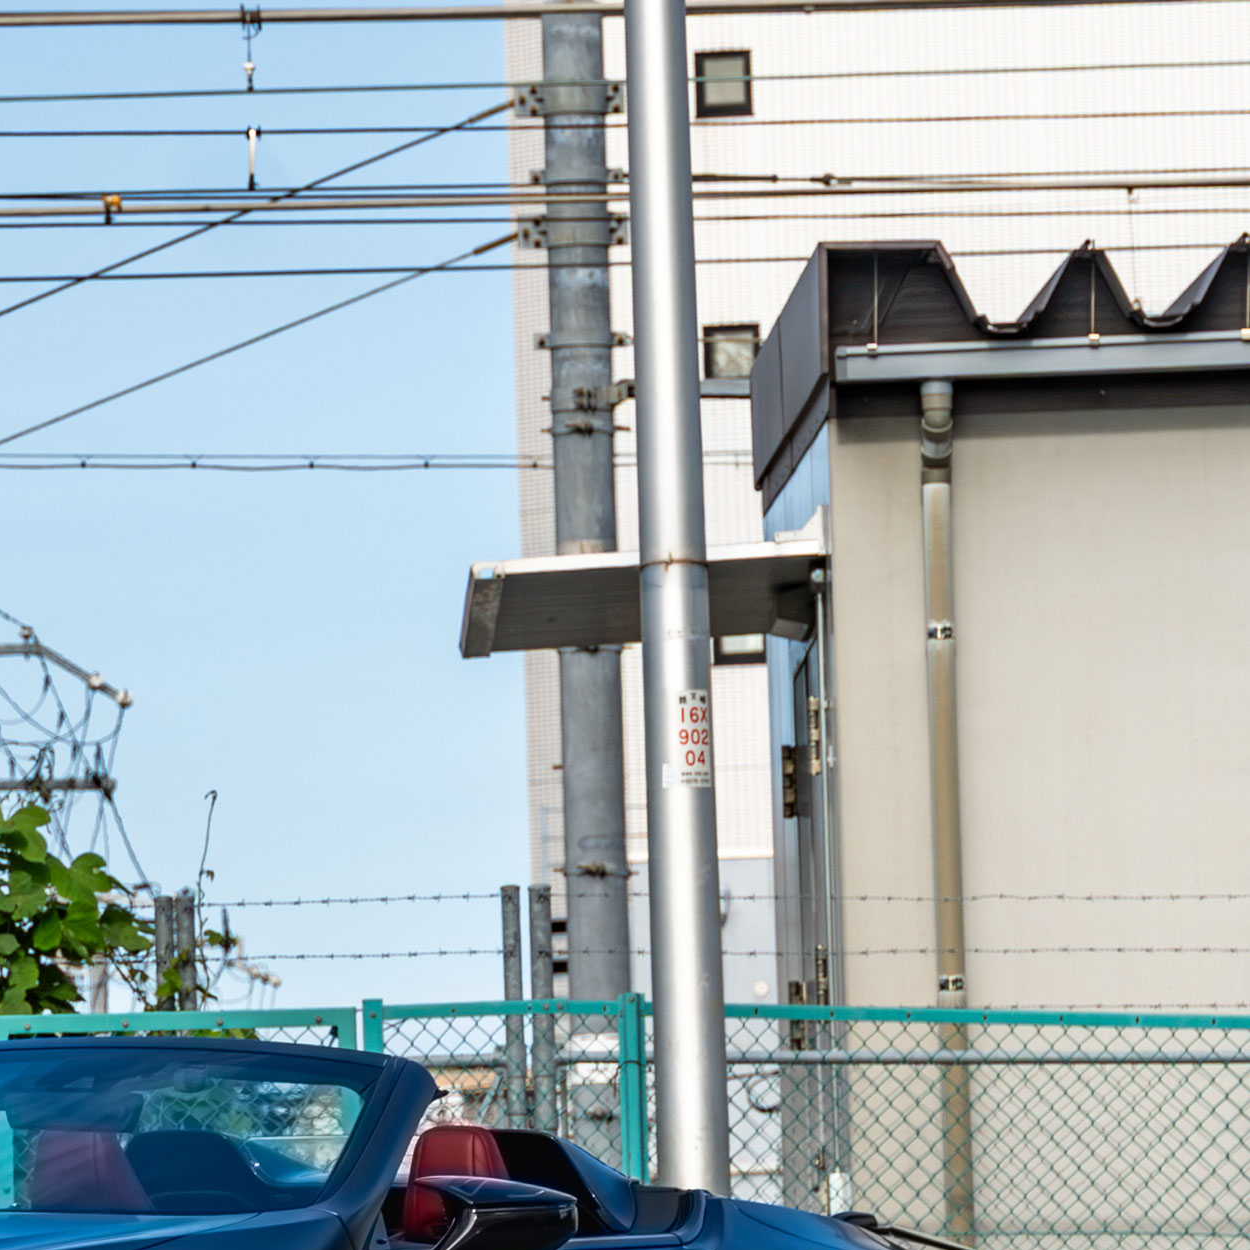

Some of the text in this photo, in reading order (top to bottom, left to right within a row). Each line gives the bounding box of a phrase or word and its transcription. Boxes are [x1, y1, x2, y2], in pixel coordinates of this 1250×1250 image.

[680, 706, 708, 723] 16X
[678, 728, 709, 745] 902
[685, 750, 706, 767] 04
